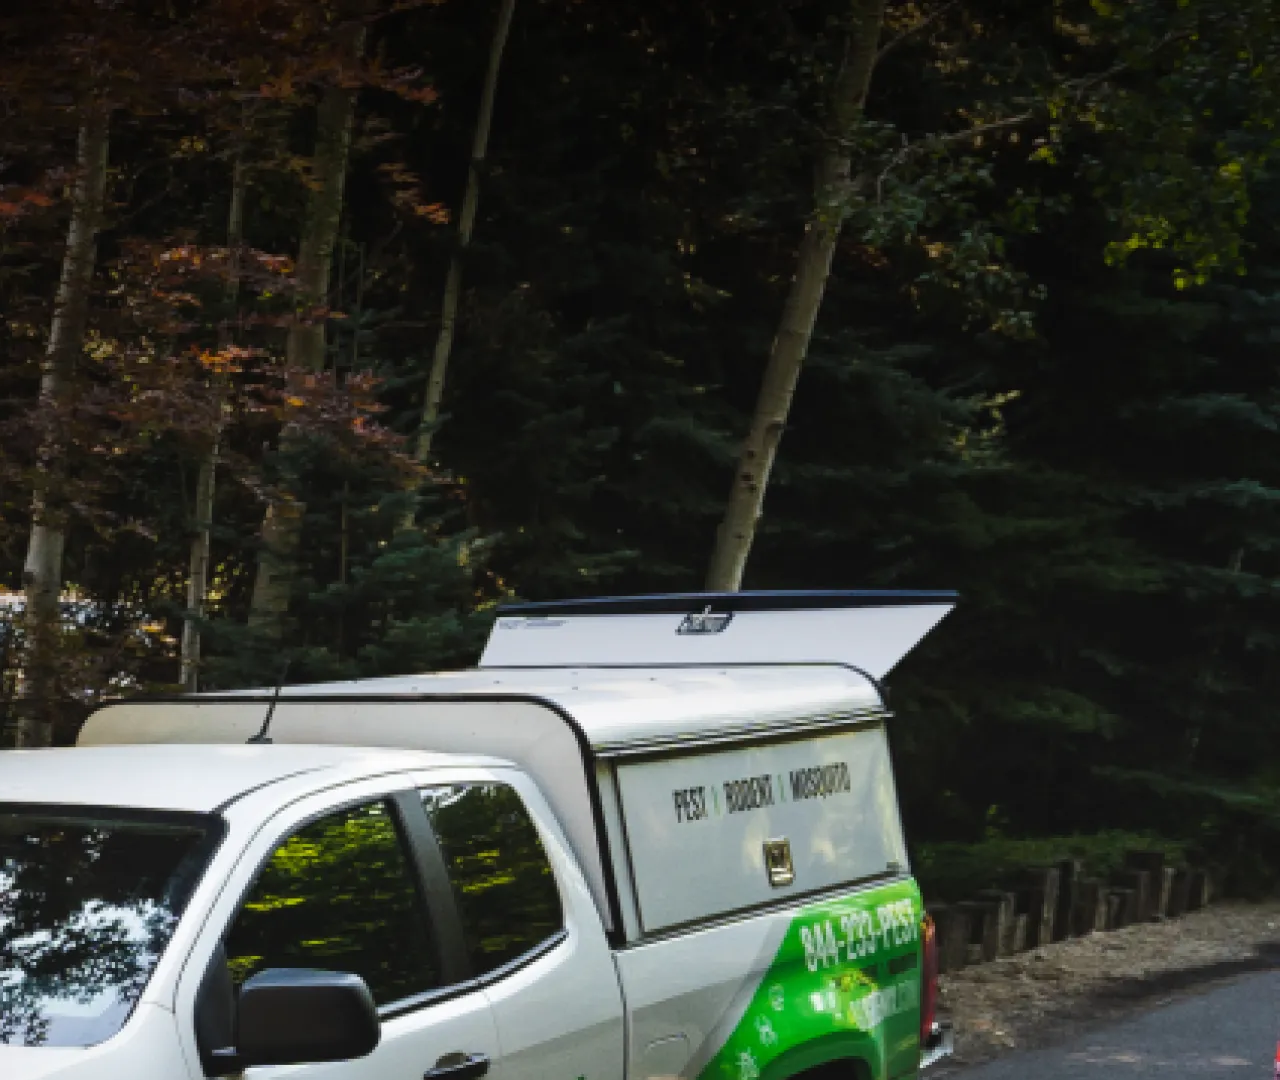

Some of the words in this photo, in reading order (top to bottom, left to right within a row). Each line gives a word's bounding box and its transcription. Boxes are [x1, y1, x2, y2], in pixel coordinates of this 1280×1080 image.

[672, 785, 708, 823] PEST
[723, 773, 775, 814] RODENT
[789, 761, 851, 802] MOSQUITO
